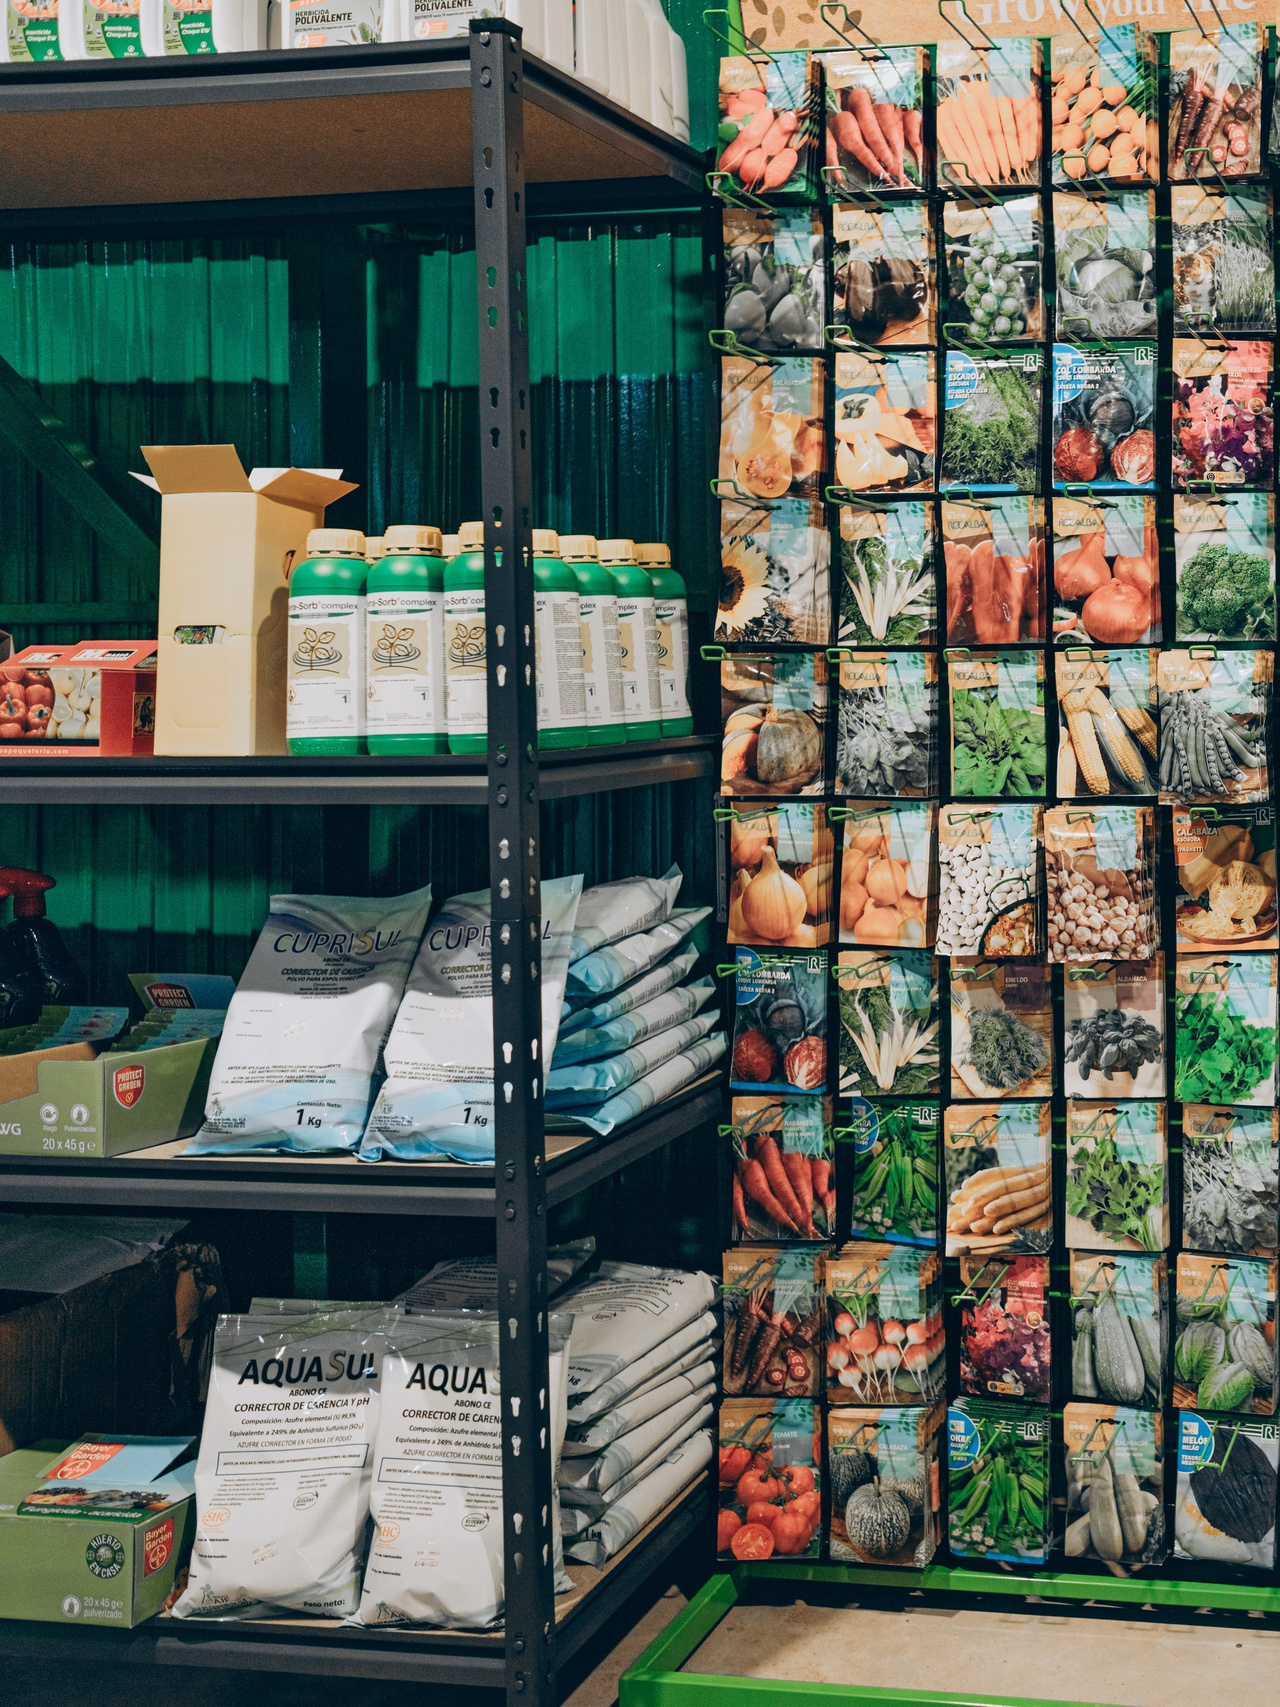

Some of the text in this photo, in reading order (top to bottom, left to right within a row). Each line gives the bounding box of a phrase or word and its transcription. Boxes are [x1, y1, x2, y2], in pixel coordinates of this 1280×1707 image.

[414, 0, 473, 13] POLIVALENTE
[295, 9, 329, 17] HERBICIDA
[955, 0, 1084, 25] Grow
[295, 13, 352, 26] POLIVALENTE
[948, 372, 985, 381] ESCAROLA
[1176, 827, 1218, 836] CALABAZA
[274, 928, 401, 955] CUPRISUL
[441, 964, 484, 975] CORRECTOR
[1005, 976, 1028, 984] ENELDO
[1117, 975, 1148, 983] ALBAHACA
[152, 989, 186, 998] PROTECT
[118, 1070, 142, 1082] PROTECT
[118, 1080, 141, 1092] GARDEN
[296, 1108, 322, 1128] 1 Kg
[463, 1107, 488, 1127] 1 Kg
[784, 1119, 814, 1128] RABANITO
[43, 1138, 55, 1150] 20
[57, 1141, 62, 1149] x
[65, 1139, 77, 1150] 45
[238, 1350, 378, 1388] AQUASUL
[289, 1387, 327, 1397] ABONO CE
[234, 1402, 290, 1412] CORRECTOR
[293, 1402, 303, 1410] DE
[351, 1398, 356, 1406] Y
[357, 1397, 370, 1407] pH
[454, 1400, 481, 1408] ABONO
[403, 1409, 470, 1422] CORRECTOR DE
[242, 1417, 283, 1425] Composición:
[298, 1426, 324, 1434] Anhídrido
[774, 1431, 798, 1439] TOMATE
[80, 1443, 113, 1452] Bayer
[261, 1439, 296, 1448] CORRECTOR
[71, 1451, 111, 1461] Garden
[205, 1512, 228, 1522] SHC
[146, 1524, 167, 1541] Bayer
[146, 1532, 172, 1550] Garden
[90, 1534, 121, 1578] HUERTO EN CASA
[84, 1597, 109, 1607] 20 45
[324, 1599, 345, 1607] neto:
[84, 1608, 122, 1618] pulverizado
